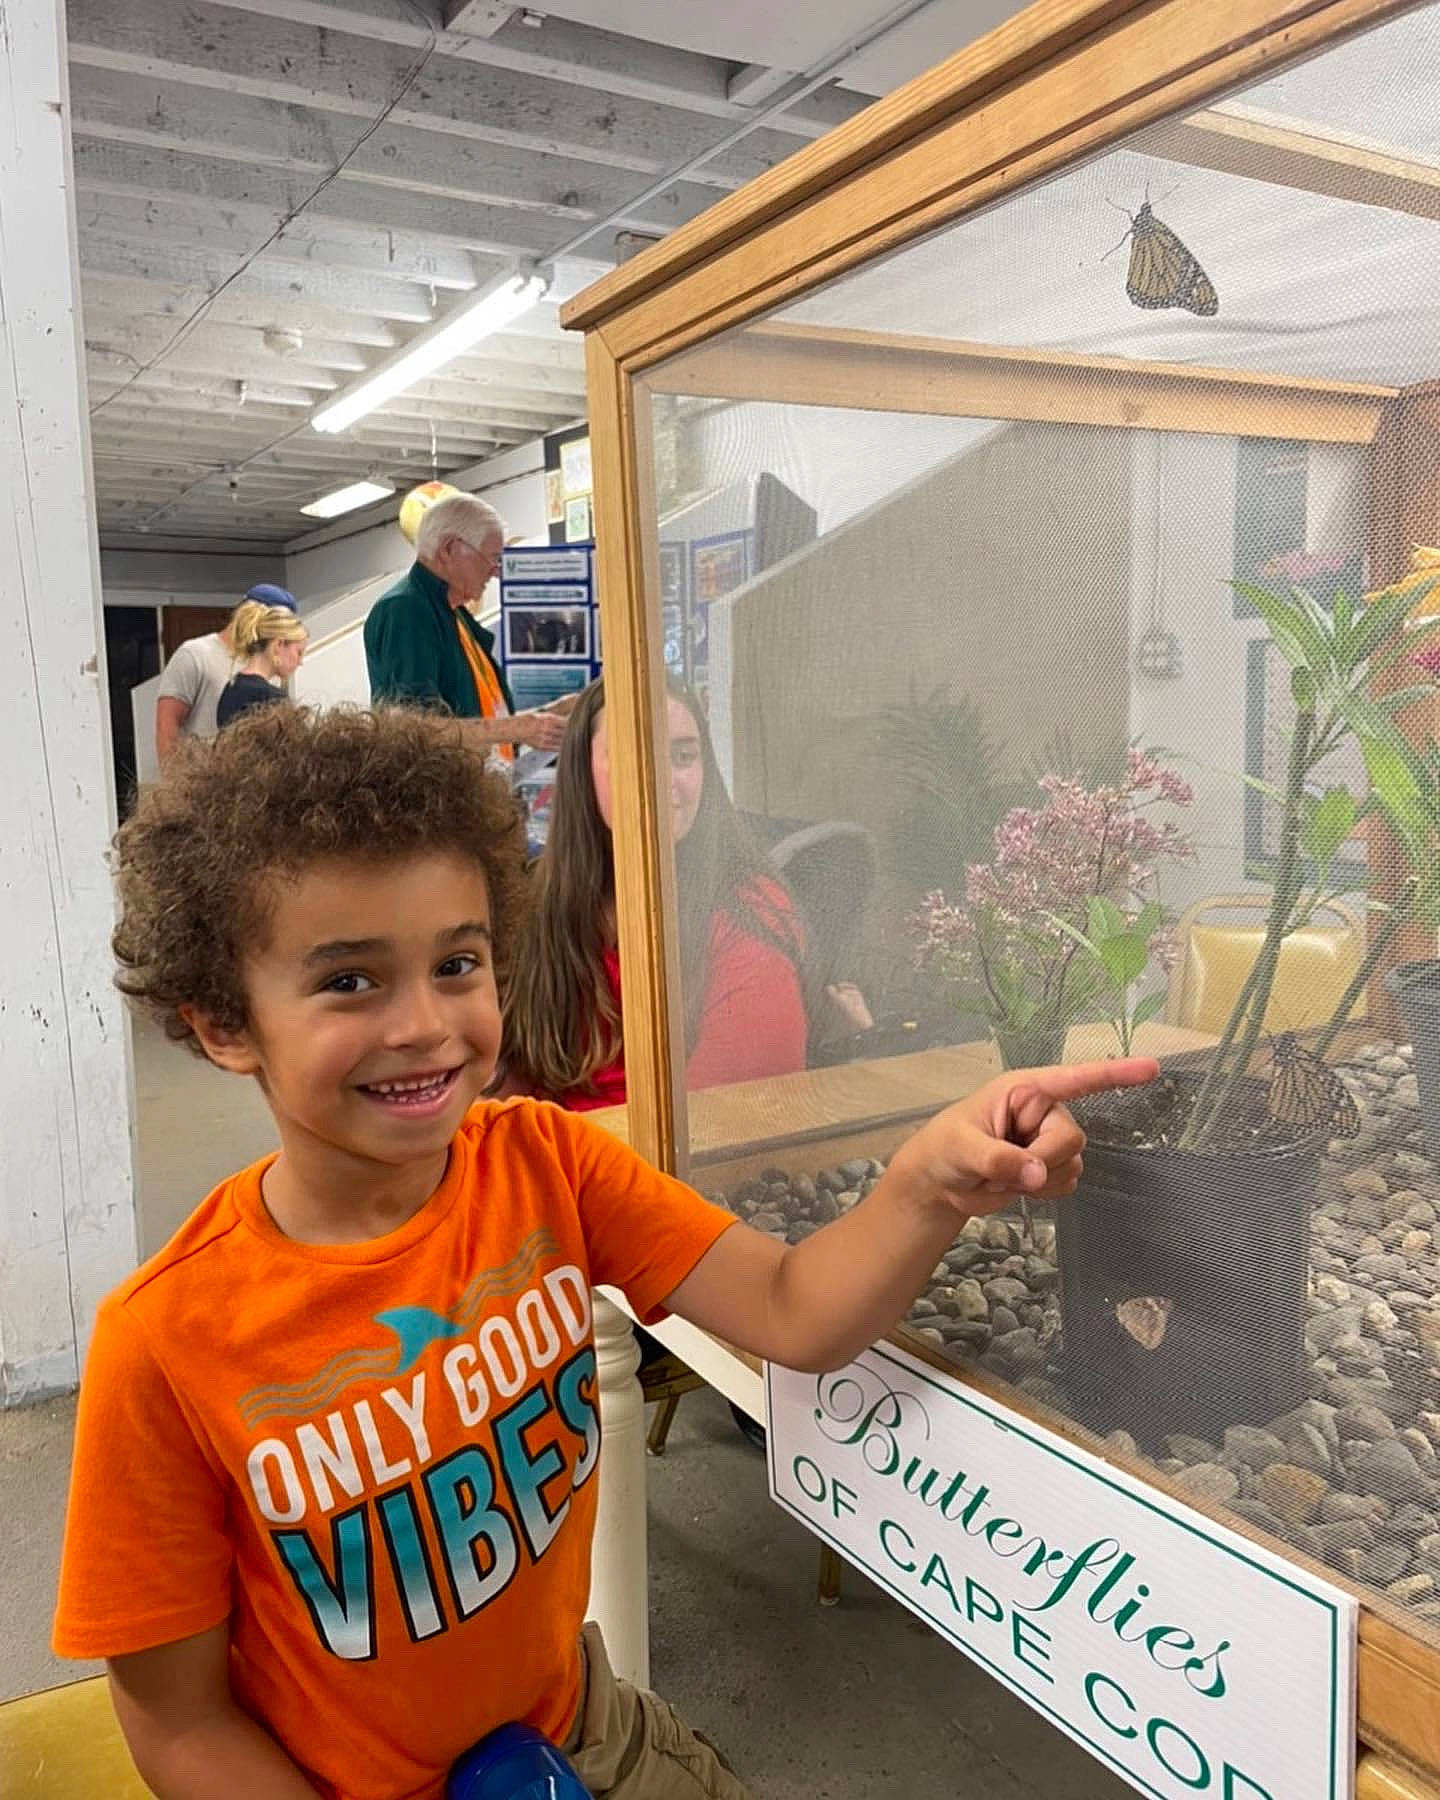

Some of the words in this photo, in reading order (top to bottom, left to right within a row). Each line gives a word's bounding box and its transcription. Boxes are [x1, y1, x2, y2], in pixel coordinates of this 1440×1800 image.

[246, 1371, 432, 1523] ONLY
[442, 1265, 592, 1427] GOOD
[270, 1345, 602, 1661] VIBES
[814, 1361, 1232, 1698] Butterflies
[792, 1456, 858, 1519] OF
[878, 1520, 1054, 1684] CAPE
